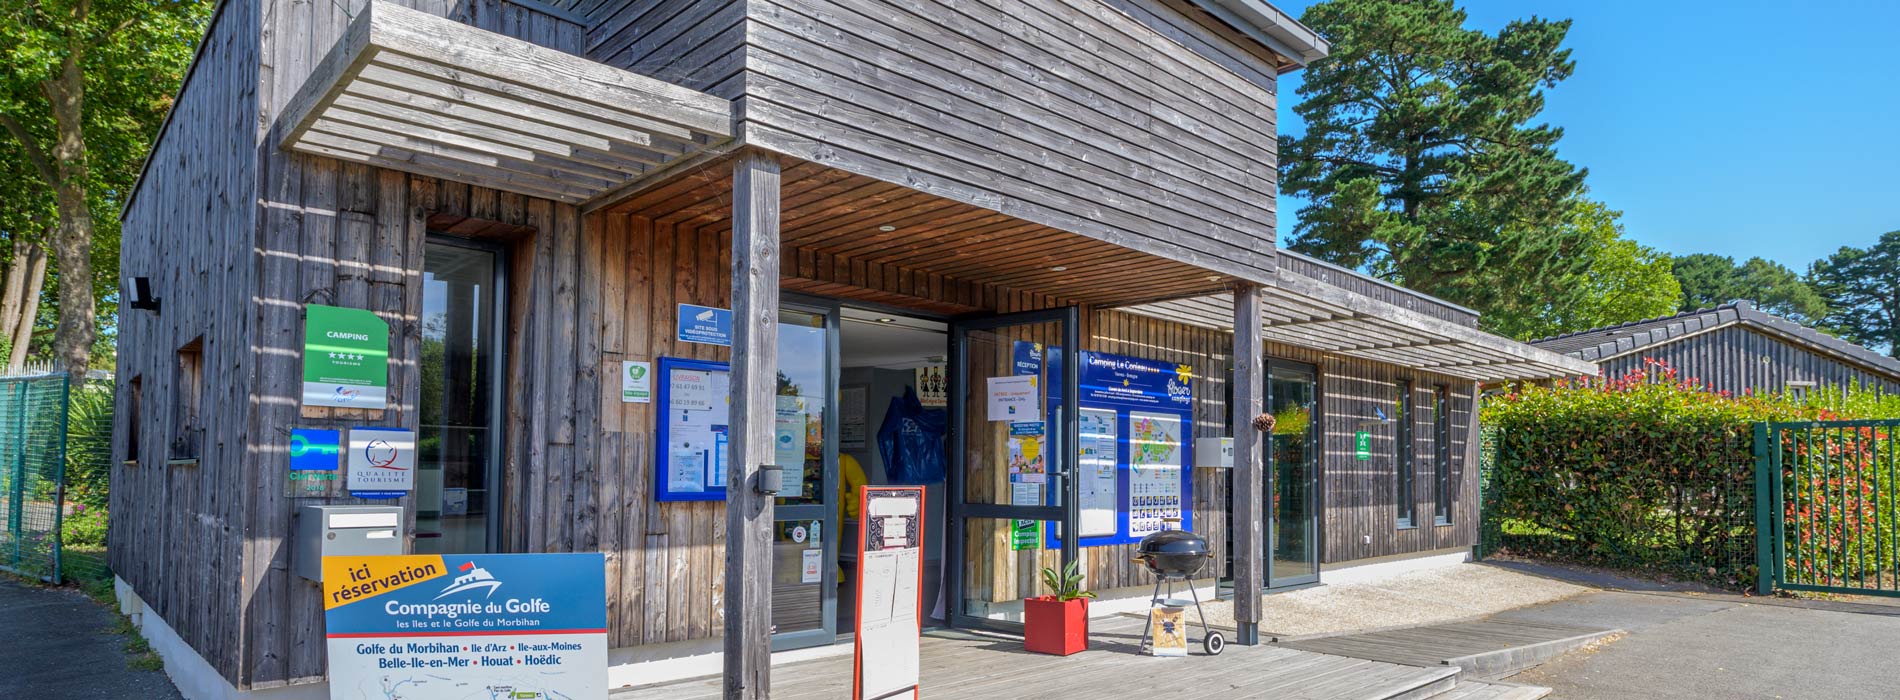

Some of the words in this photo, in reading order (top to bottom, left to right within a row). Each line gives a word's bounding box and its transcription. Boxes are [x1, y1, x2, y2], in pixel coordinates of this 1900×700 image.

[326, 331, 369, 341] CAMPING
[1089, 355, 1116, 370] Camping
[1117, 359, 1125, 369] Le
[289, 472, 310, 481] Clef
[312, 472, 338, 481] Verte
[1014, 530, 1038, 538] Camping
[348, 563, 371, 582] ici
[332, 562, 437, 603] réservation
[384, 599, 482, 618] Compagnie
[485, 602, 502, 614] du
[505, 598, 550, 614] Golfe
[396, 620, 410, 628] les
[430, 620, 441, 628] et
[443, 619, 452, 628] le
[454, 618, 480, 628] Golfe
[483, 618, 494, 627] du
[497, 618, 540, 627] Morbihan
[356, 643, 386, 656] Golfe
[389, 643, 404, 655] du
[406, 642, 460, 655] Morbihan
[471, 643, 482, 653] Ile
[484, 643, 507, 653] d'Arz
[518, 641, 582, 653] Ile-aux-Moines
[378, 656, 470, 669] Belle-Ile-en-Mer
[481, 656, 514, 667] Houat
[525, 654, 562, 667] Hoëdic
